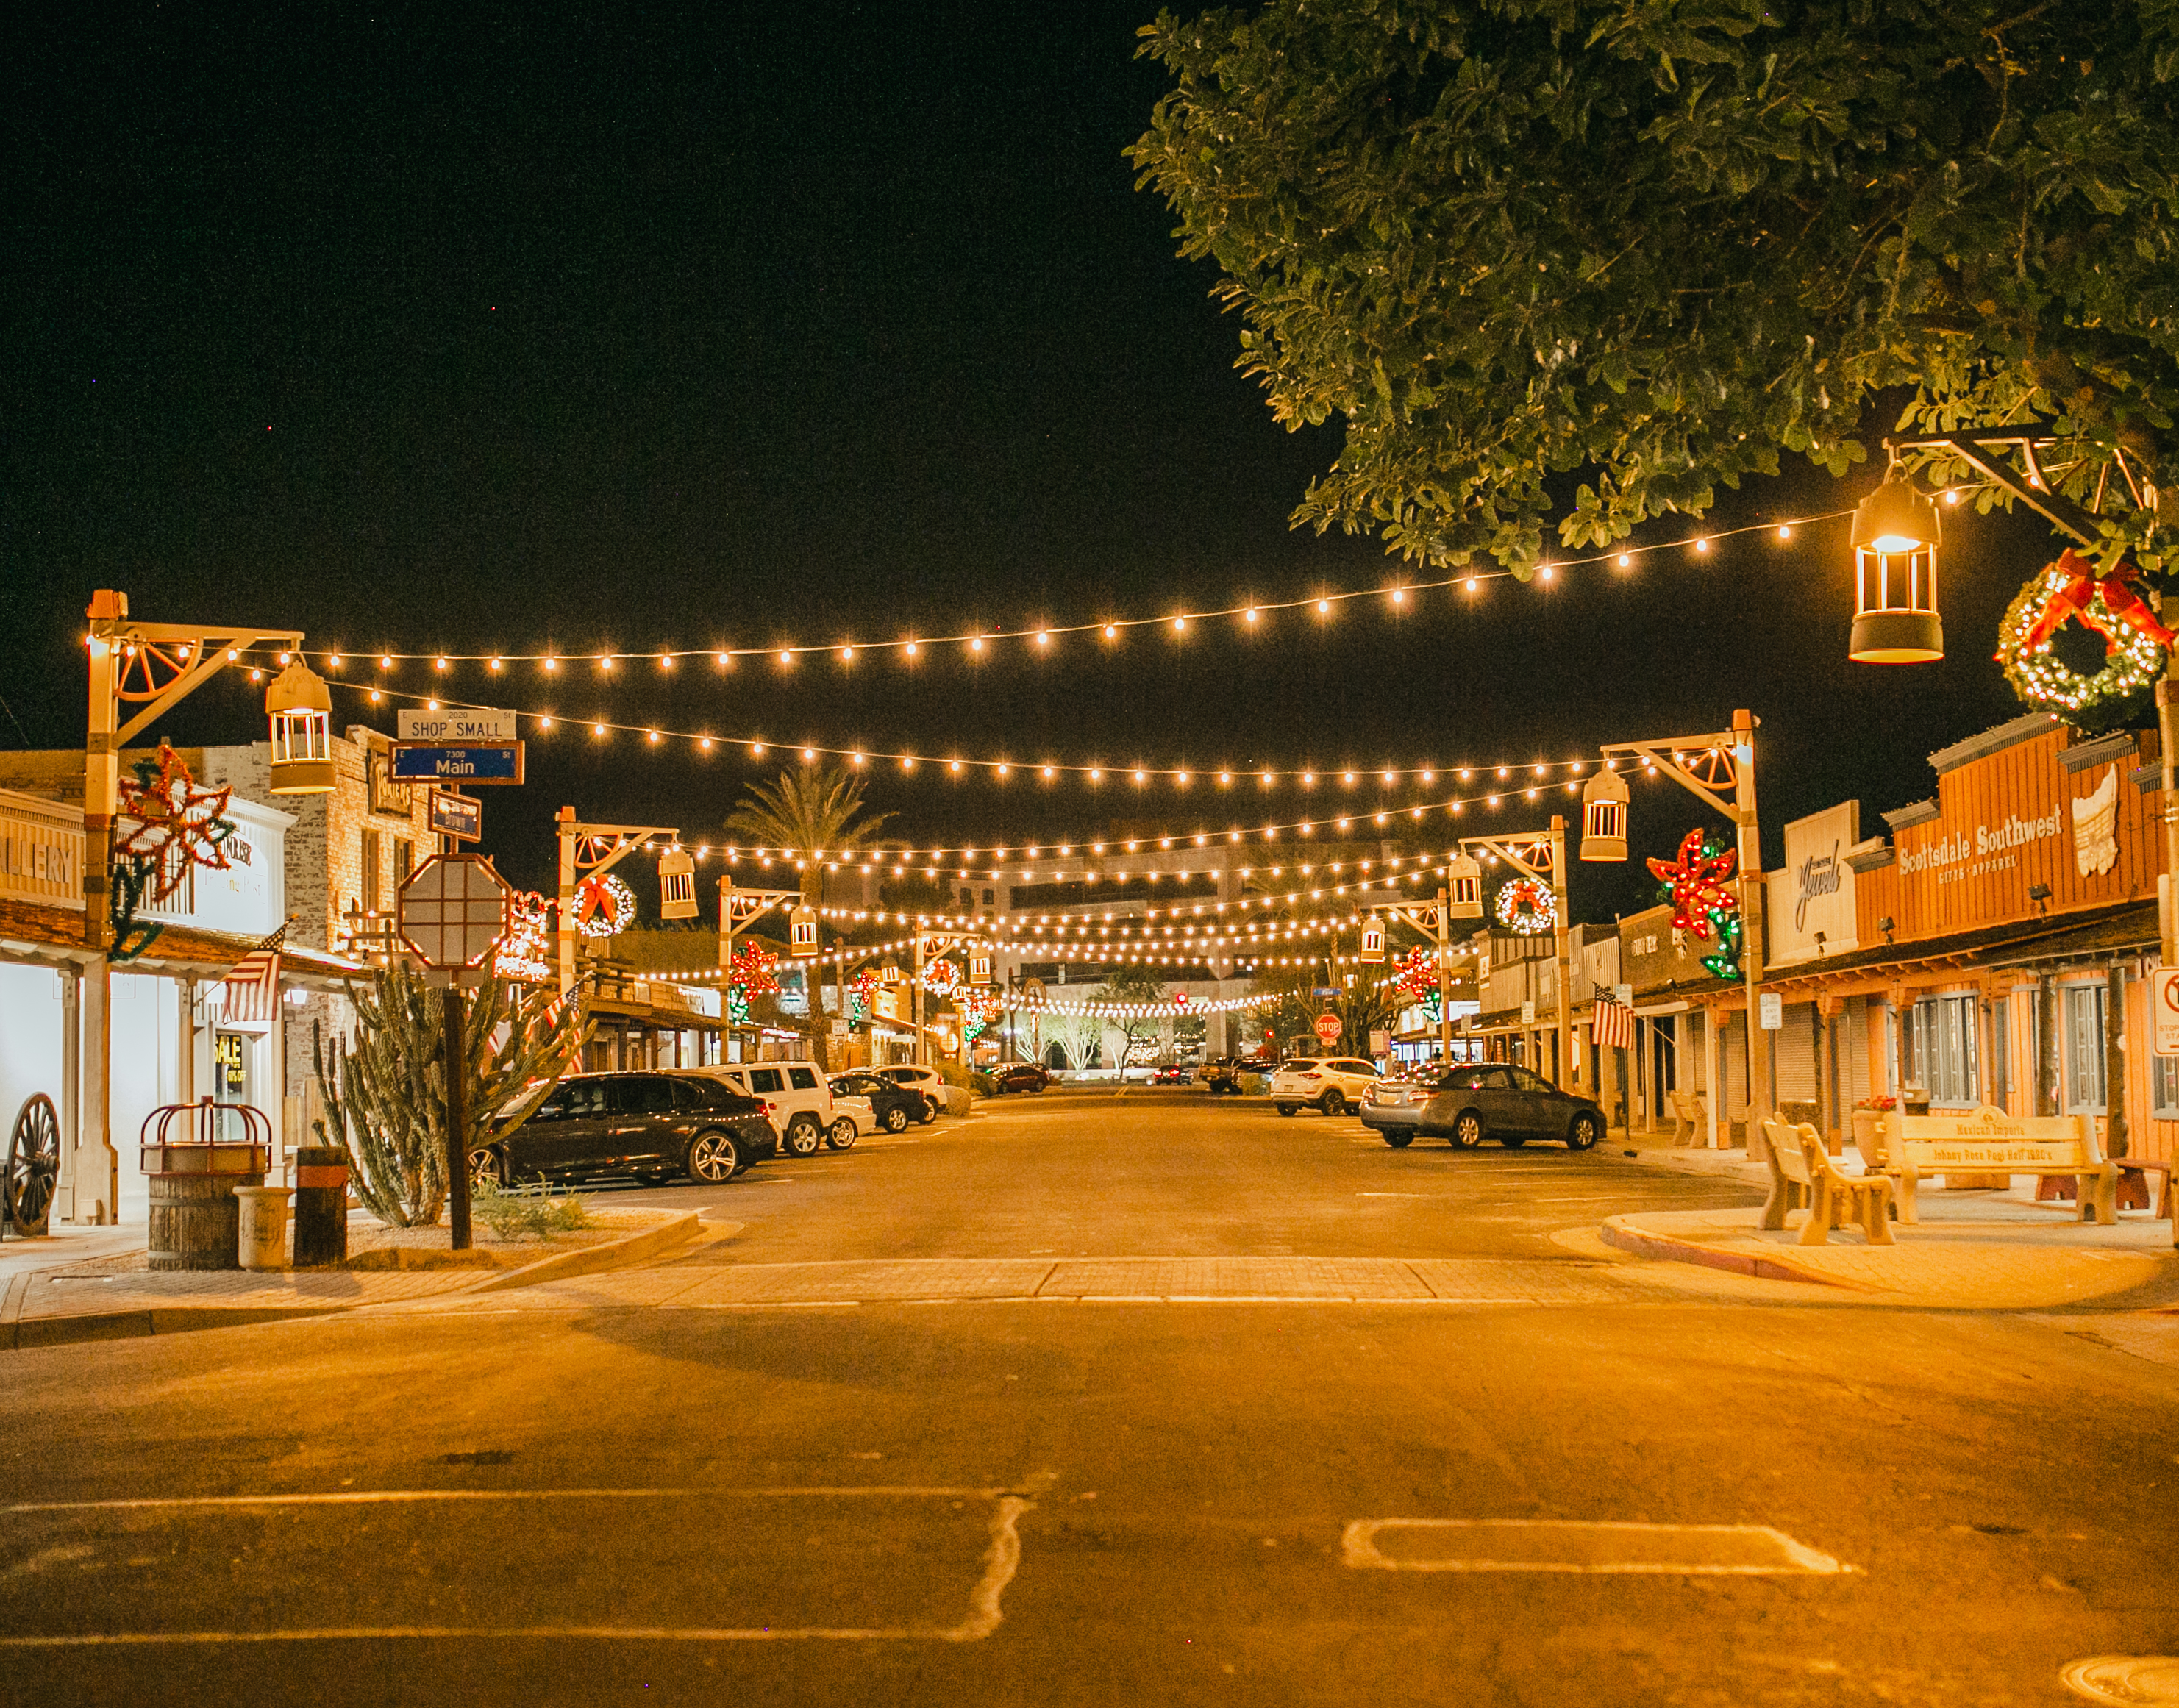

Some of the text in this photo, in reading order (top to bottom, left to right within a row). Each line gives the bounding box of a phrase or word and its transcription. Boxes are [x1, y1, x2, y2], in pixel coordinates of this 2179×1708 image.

[412, 722, 502, 736] SHOP SMALL
[435, 759, 475, 774] Main
[1899, 803, 2062, 876] Scottsdale Southwest
[1938, 854, 2017, 885] GIFTS APPAREL
[1318, 1022, 1339, 1032] STOP
[1956, 1123, 2025, 1137] Mexican Imports
[1933, 1149, 1962, 1162] Johnny
[1964, 1149, 1984, 1161] Rose
